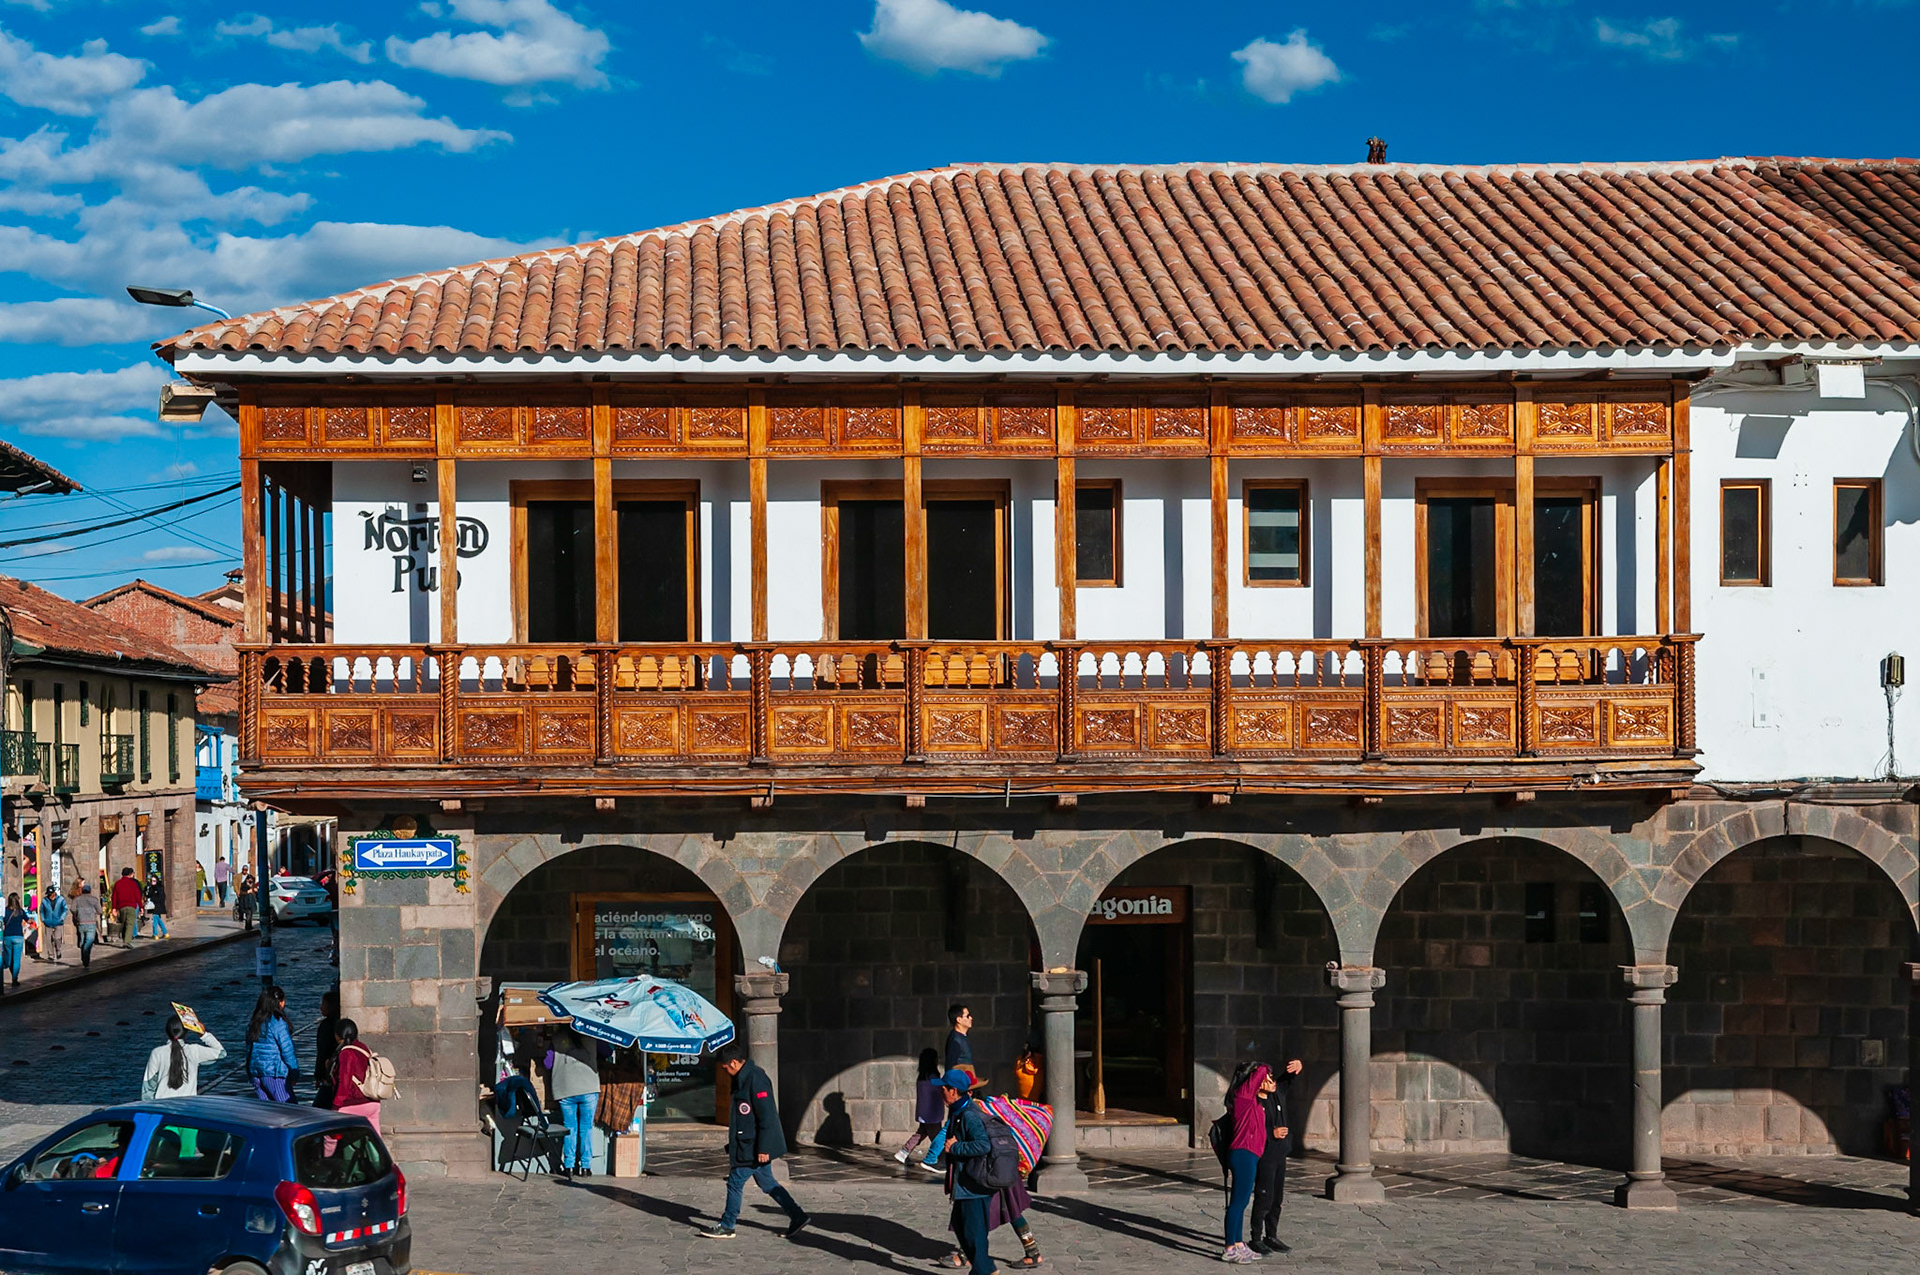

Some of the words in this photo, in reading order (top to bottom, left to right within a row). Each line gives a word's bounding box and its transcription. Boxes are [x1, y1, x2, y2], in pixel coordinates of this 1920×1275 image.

[391, 555, 461, 593] Pu
[373, 849, 393, 858] Plaza
[394, 848, 443, 860] Haukaypata
[1089, 895, 1173, 920] agonia
[595, 911, 671, 923] aciéndonos
[604, 928, 615, 940] la
[608, 946, 661, 956] océano.
